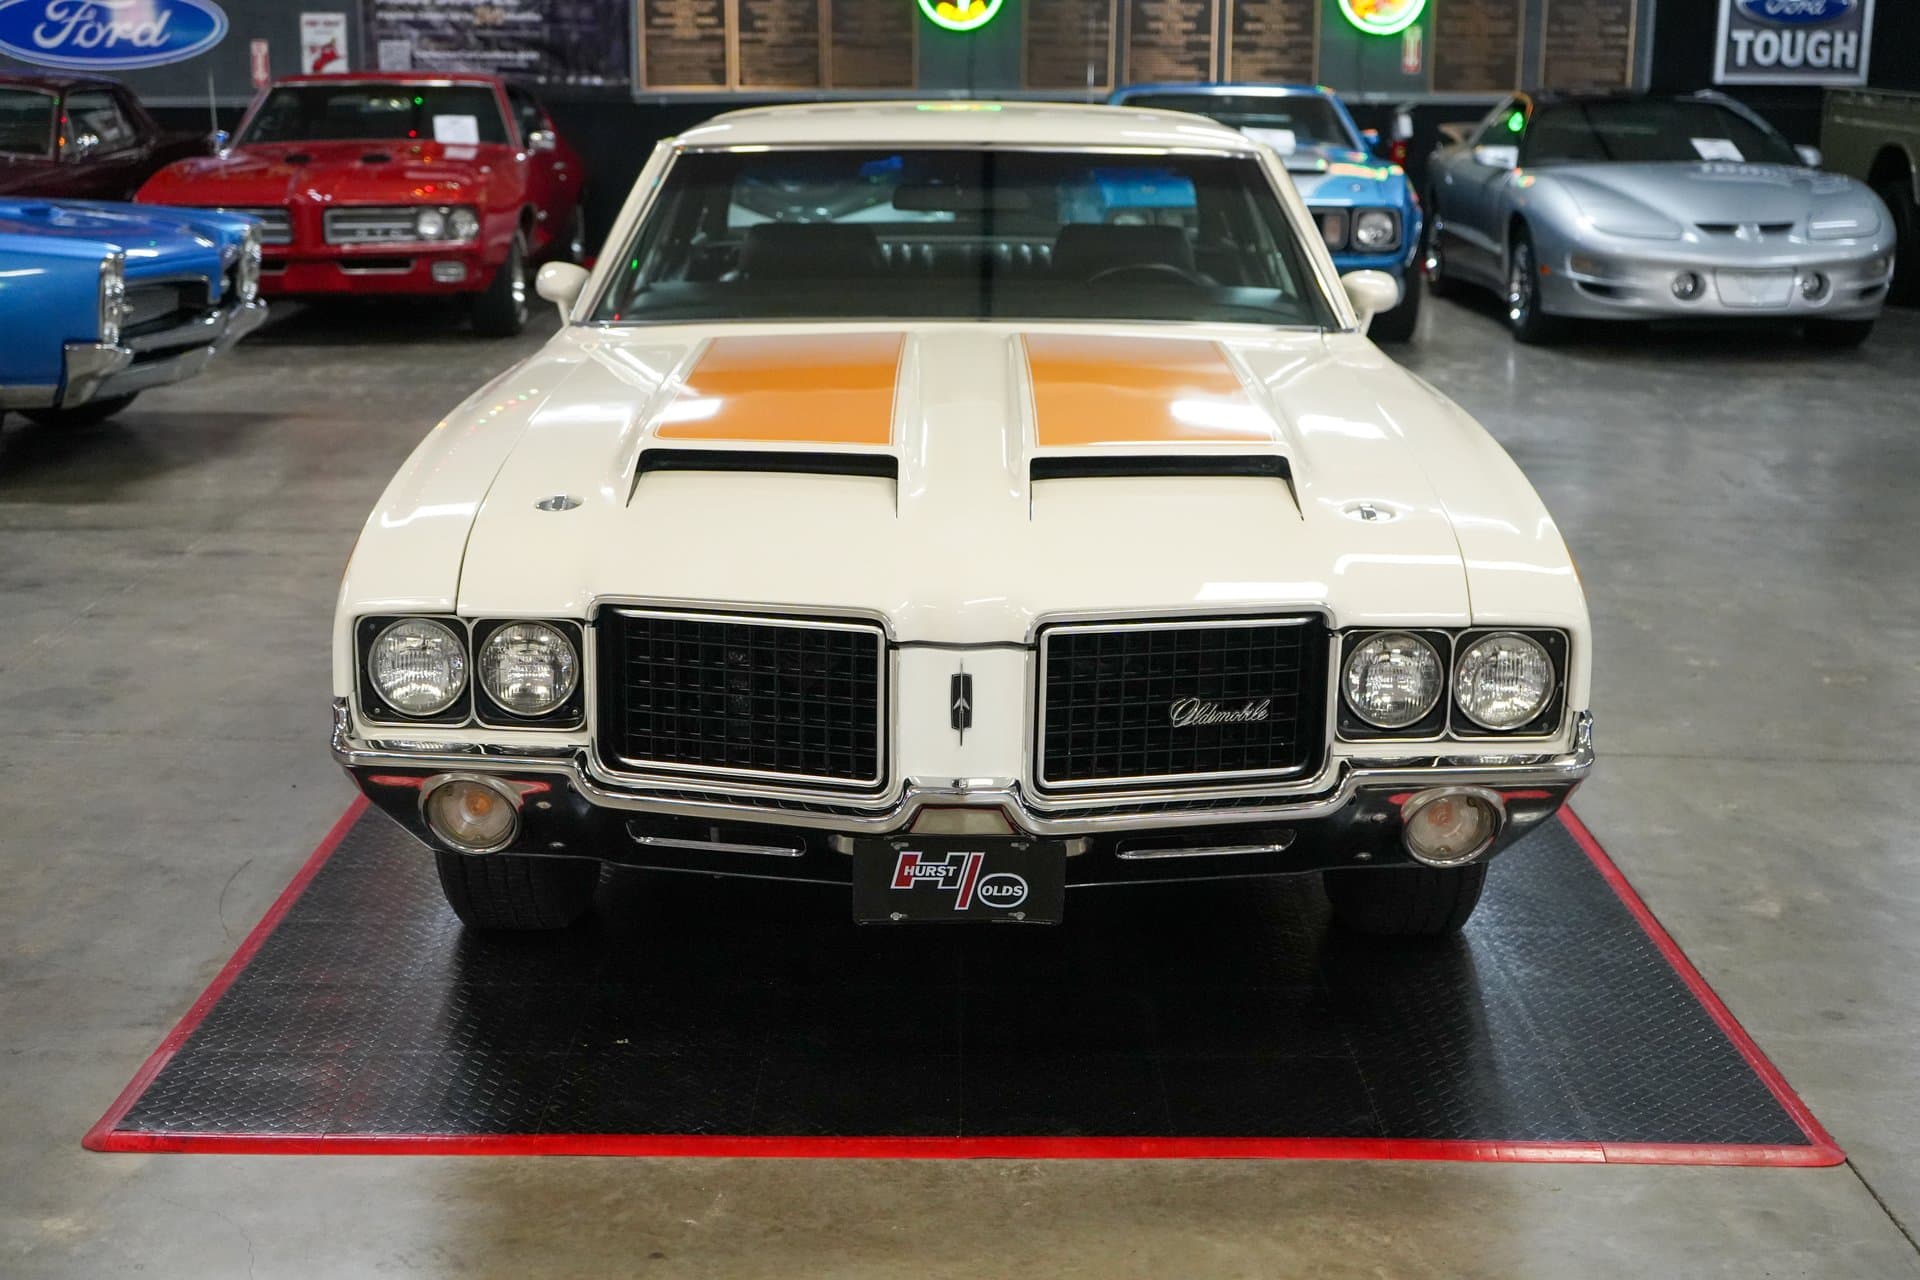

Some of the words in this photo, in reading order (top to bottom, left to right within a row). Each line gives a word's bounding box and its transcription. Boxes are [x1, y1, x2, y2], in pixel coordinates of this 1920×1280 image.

[33, 0, 171, 49] Ford
[1731, 29, 1858, 68] TOUGH
[1170, 697, 1271, 728] Oldsmobile
[903, 865, 957, 877] HURST
[981, 885, 1023, 896] OLDS
